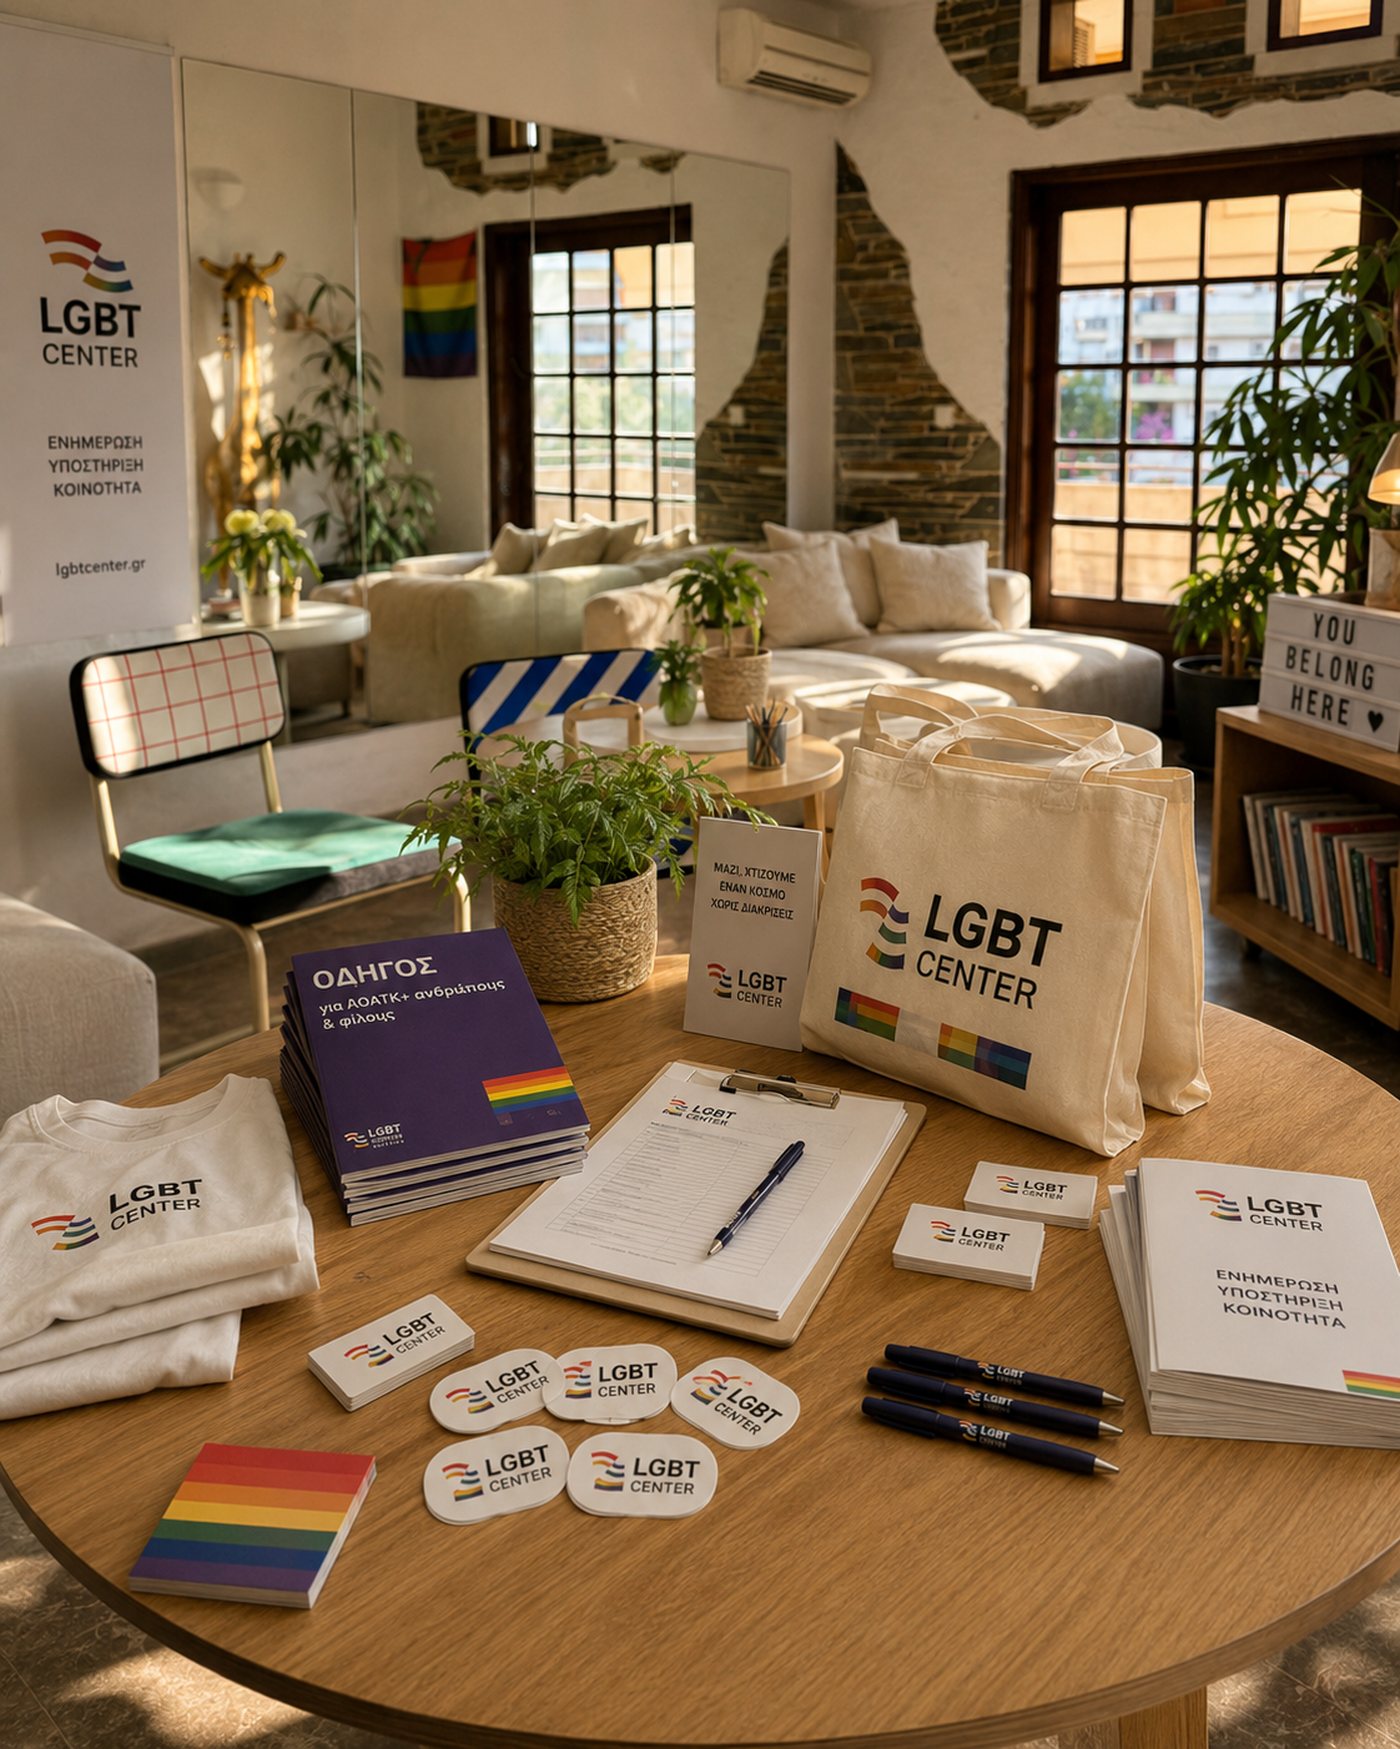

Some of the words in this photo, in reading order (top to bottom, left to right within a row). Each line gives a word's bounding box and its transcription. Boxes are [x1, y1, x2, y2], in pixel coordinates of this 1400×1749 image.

[40, 296, 141, 338] LGBT
[42, 343, 138, 368] CENTER
[48, 435, 143, 450] ΕΝΗΜΕΡΩΣΗ
[48, 458, 144, 473] ΥΠΟΣΤΗΡΙΞΗ
[53, 481, 142, 497] ΚΟΙΝΟΤΗΤΑ
[56, 558, 146, 579] lgbtcenter.gr
[1314, 612, 1355, 645] YOU
[1286, 645, 1374, 690] BELONG
[1290, 684, 1350, 726] HERE
[745, 867, 796, 884] ΧΤΙΖΟΥΜΕ
[719, 880, 747, 894] ΕΝΑΝ
[749, 886, 786, 900] ΚΟΣΜΟ
[711, 898, 739, 912] ΧΩΡΙΣ
[741, 902, 794, 920] ΔΙΑΚΡΙΣΕΙΣ
[924, 894, 1063, 967] LGBT
[312, 956, 438, 989] ΟΔΗΓΟΣ
[738, 969, 787, 993] LGBT
[916, 950, 1038, 1009] CENTER
[319, 1002, 344, 1016] για
[737, 990, 782, 1008] CENTER
[322, 1018, 336, 1030] &
[686, 1113, 729, 1126] CENTER
[692, 1105, 736, 1120] LGBT
[368, 1123, 401, 1138] LGBT
[110, 1179, 202, 1214] LGBT
[1022, 1190, 1064, 1200] CENTER
[1023, 1180, 1068, 1194] LGBT
[111, 1198, 201, 1231] CENTER
[1247, 1196, 1322, 1218] LGBT
[1249, 1214, 1324, 1232] CENTER
[958, 1238, 1005, 1252] CENTER
[961, 1227, 1010, 1243] LGBT
[1216, 1269, 1340, 1295] ΕΝΗΜΕΡΩΣΗ
[1217, 1285, 1344, 1312] ΥΠΟΣΤΗΡΙΞΗ
[1223, 1302, 1347, 1329] ΚΟΙΝΟΤΗΤΑ
[382, 1312, 436, 1346] LGBT
[395, 1325, 446, 1355] CENTER
[485, 1360, 542, 1393] LGBT
[598, 1362, 658, 1382] LGBT
[496, 1375, 550, 1404] CENTER
[597, 1382, 656, 1398] CENTER
[726, 1387, 783, 1424] LGBT
[714, 1402, 762, 1436] CENTER
[485, 1444, 549, 1477] LGBT
[633, 1457, 700, 1479] LGBT
[489, 1466, 552, 1493] CENTER
[630, 1480, 695, 1495] CENTER
